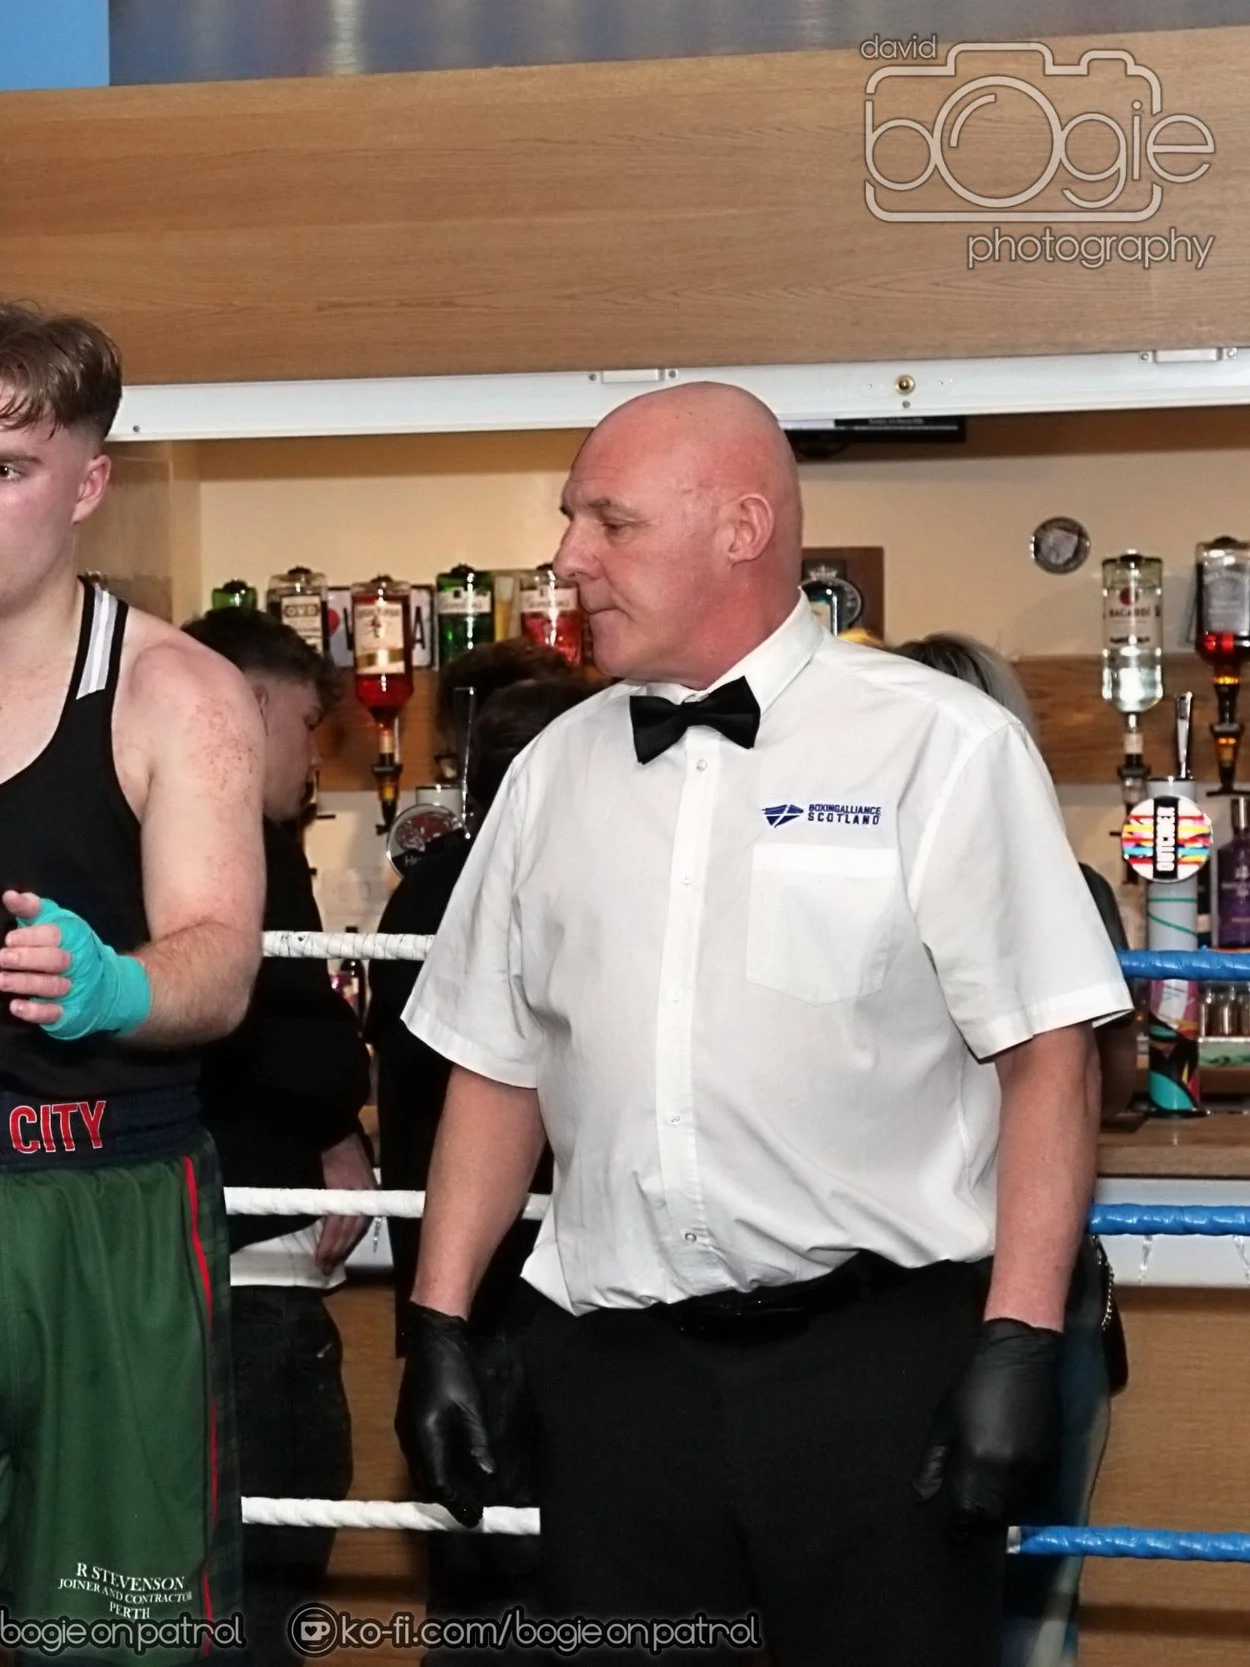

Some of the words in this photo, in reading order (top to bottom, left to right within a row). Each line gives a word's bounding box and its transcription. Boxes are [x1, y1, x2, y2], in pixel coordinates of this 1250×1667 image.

[808, 812, 880, 825] SCOTLAND
[9, 1100, 107, 1154] CITY
[76, 1562, 88, 1578] R
[91, 1565, 186, 1592] STEVENSON
[58, 1578, 100, 1593] JOINER
[102, 1586, 124, 1601] AND
[109, 1601, 151, 1620] PERTH
